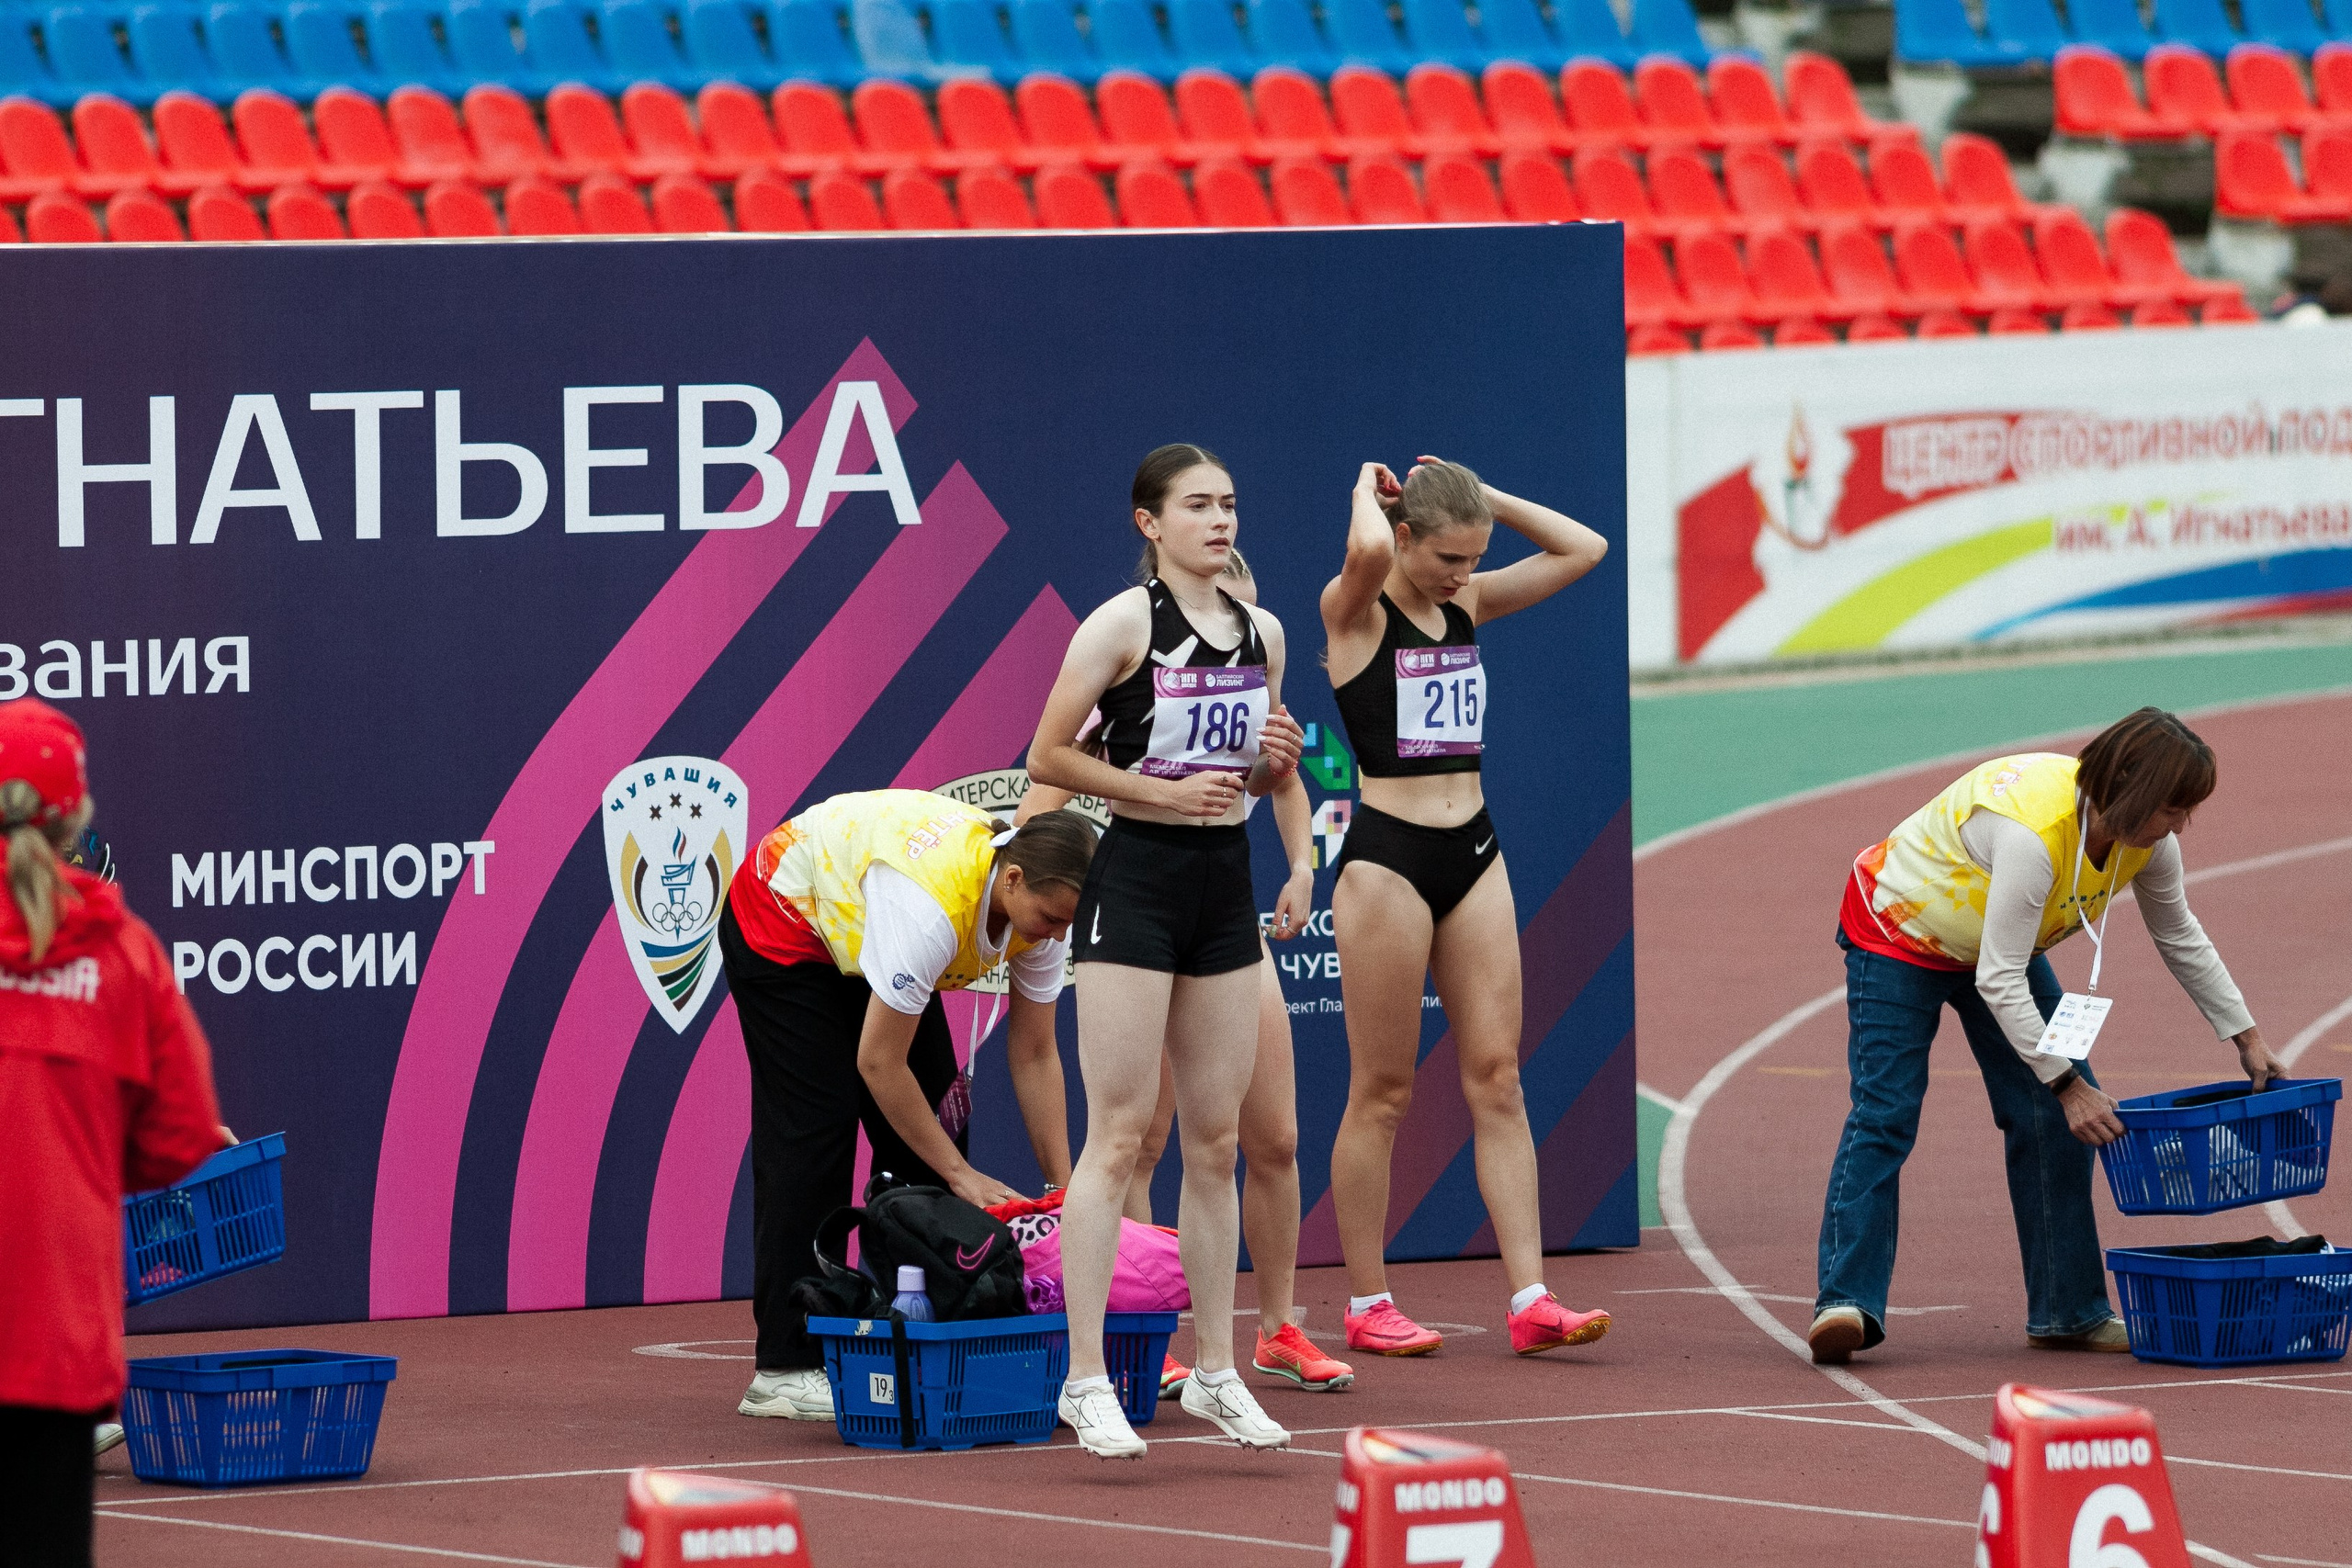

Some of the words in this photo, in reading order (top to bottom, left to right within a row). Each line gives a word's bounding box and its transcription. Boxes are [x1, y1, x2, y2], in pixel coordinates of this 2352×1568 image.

[0, 380, 922, 547] НАТЬЕВА
[1424, 678, 1477, 728] 215
[1185, 702, 1250, 753] 186
[610, 767, 738, 812] ЧУВАШИЯ
[172, 840, 495, 908] МИНСПОРТ
[174, 931, 417, 995] РОССИИ
[874, 1377, 888, 1397] 19
[2044, 1437, 2152, 1472] MONDO
[1395, 1476, 1507, 1513] MONDO
[681, 1524, 797, 1561] MONDO
